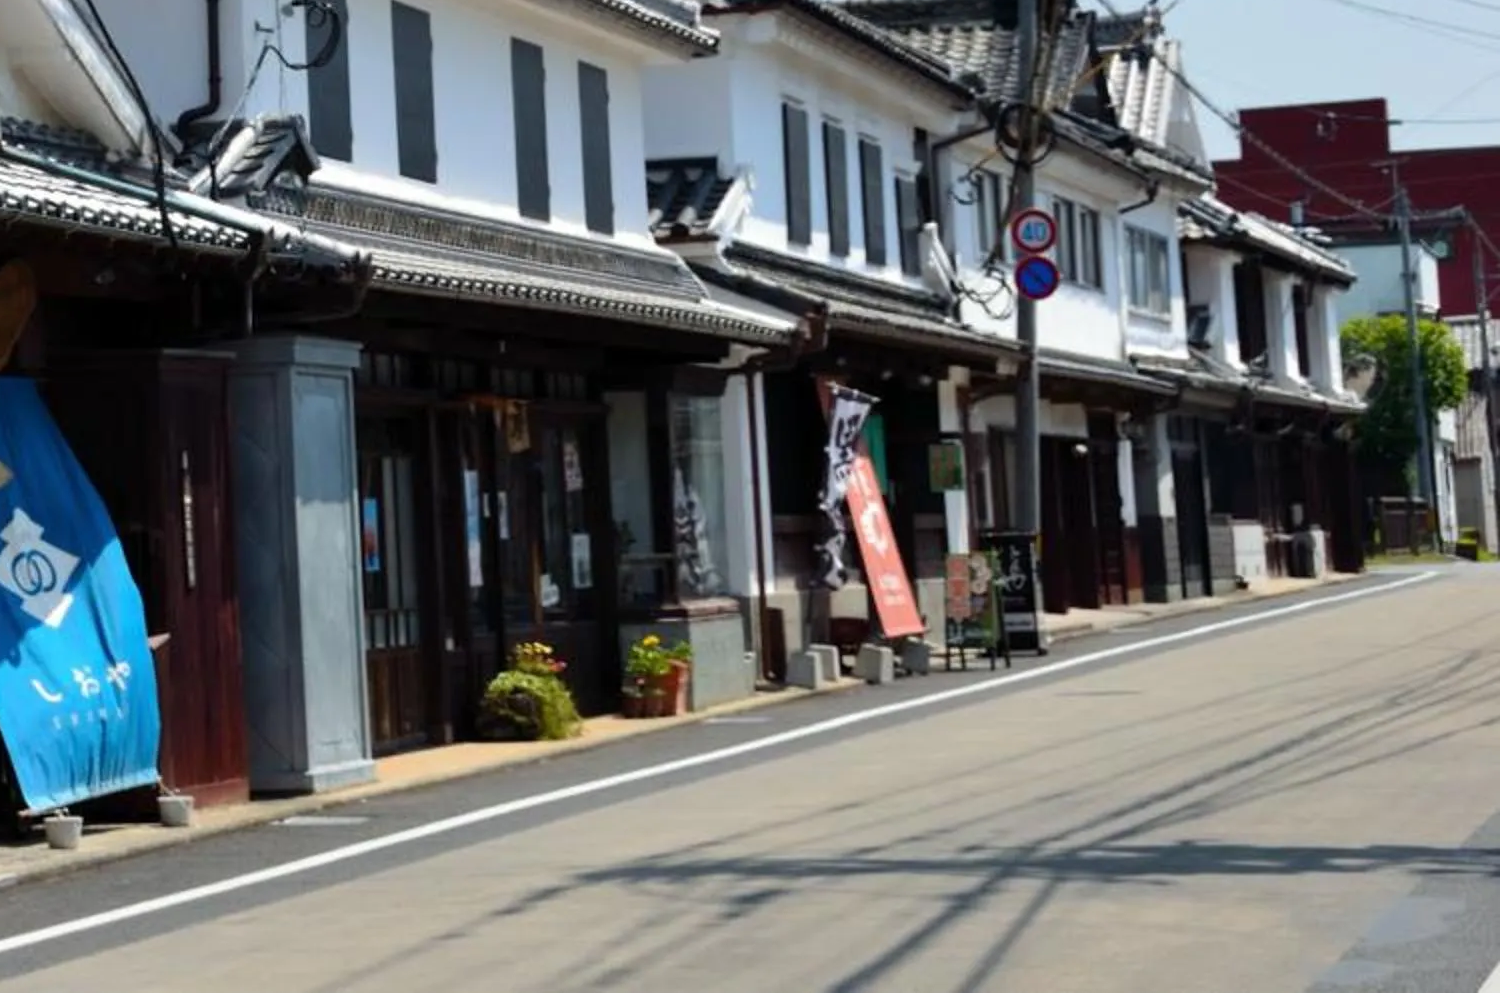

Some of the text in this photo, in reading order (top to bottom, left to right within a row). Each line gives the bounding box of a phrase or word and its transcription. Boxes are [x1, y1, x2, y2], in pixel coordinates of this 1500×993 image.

[1022, 220, 1048, 241] 40
[30, 662, 131, 702] しおや
